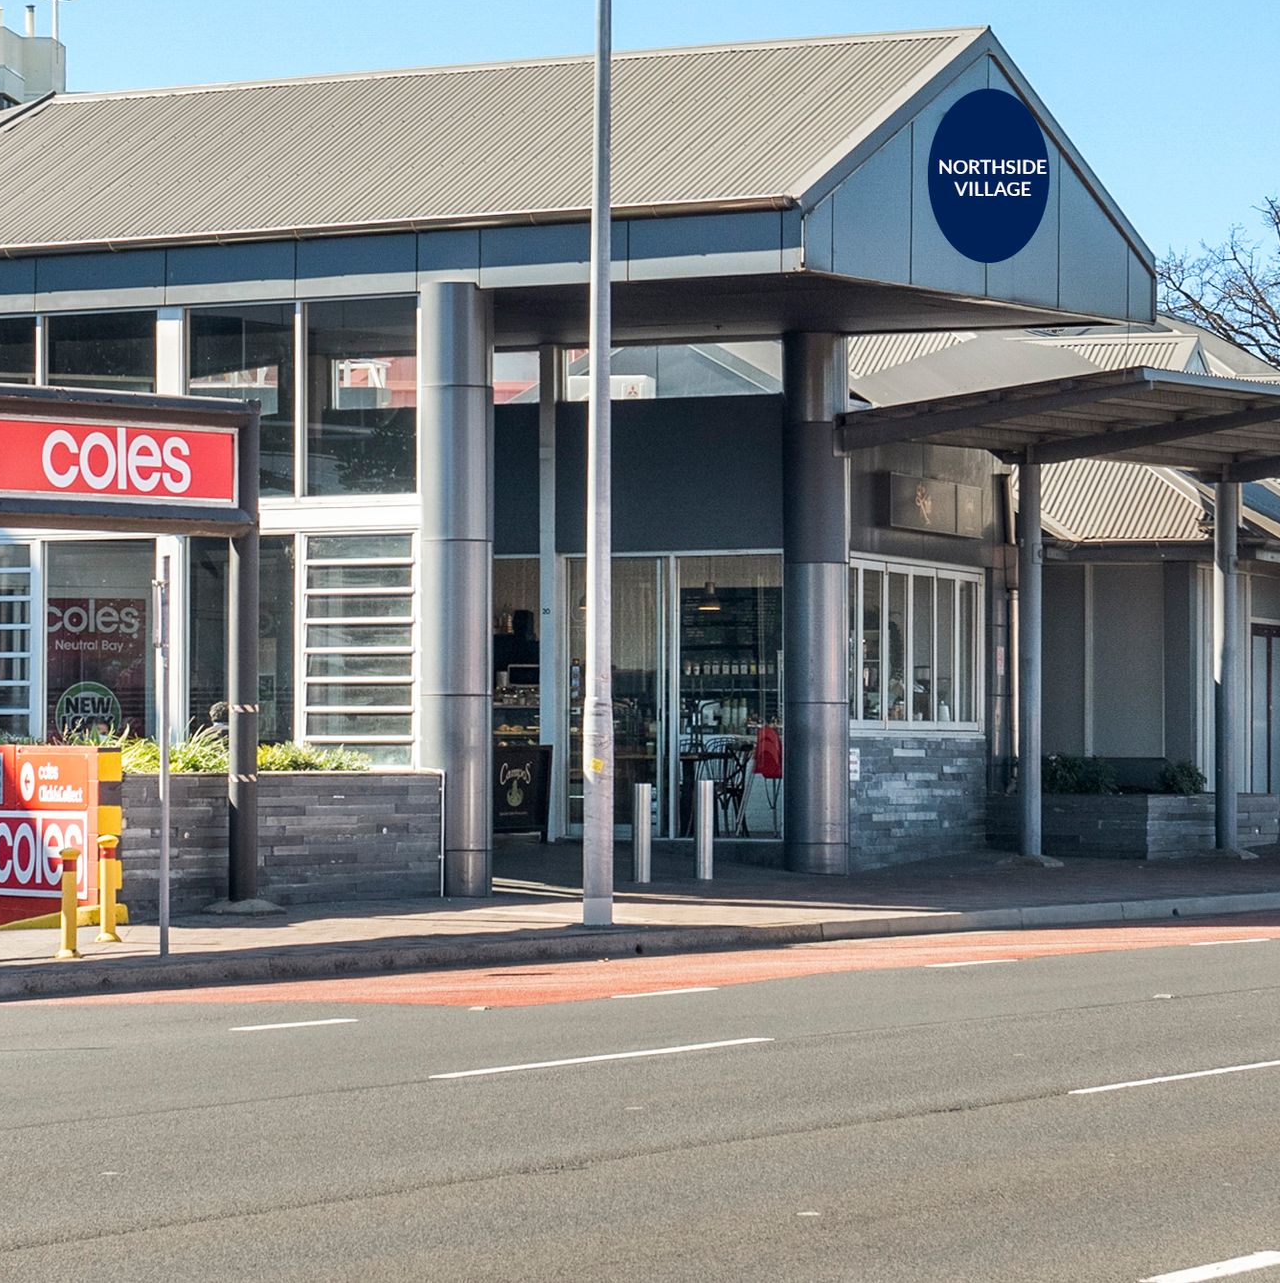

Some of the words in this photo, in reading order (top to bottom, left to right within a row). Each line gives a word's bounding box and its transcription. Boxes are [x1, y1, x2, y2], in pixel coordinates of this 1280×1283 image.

[939, 159, 1047, 174] NORTHSIDE
[954, 181, 1032, 196] VILLAGE
[42, 427, 191, 493] coles
[48, 599, 140, 633] coles
[55, 640, 97, 651] Neutral
[101, 640, 124, 652] Bay
[65, 696, 113, 714] NEW
